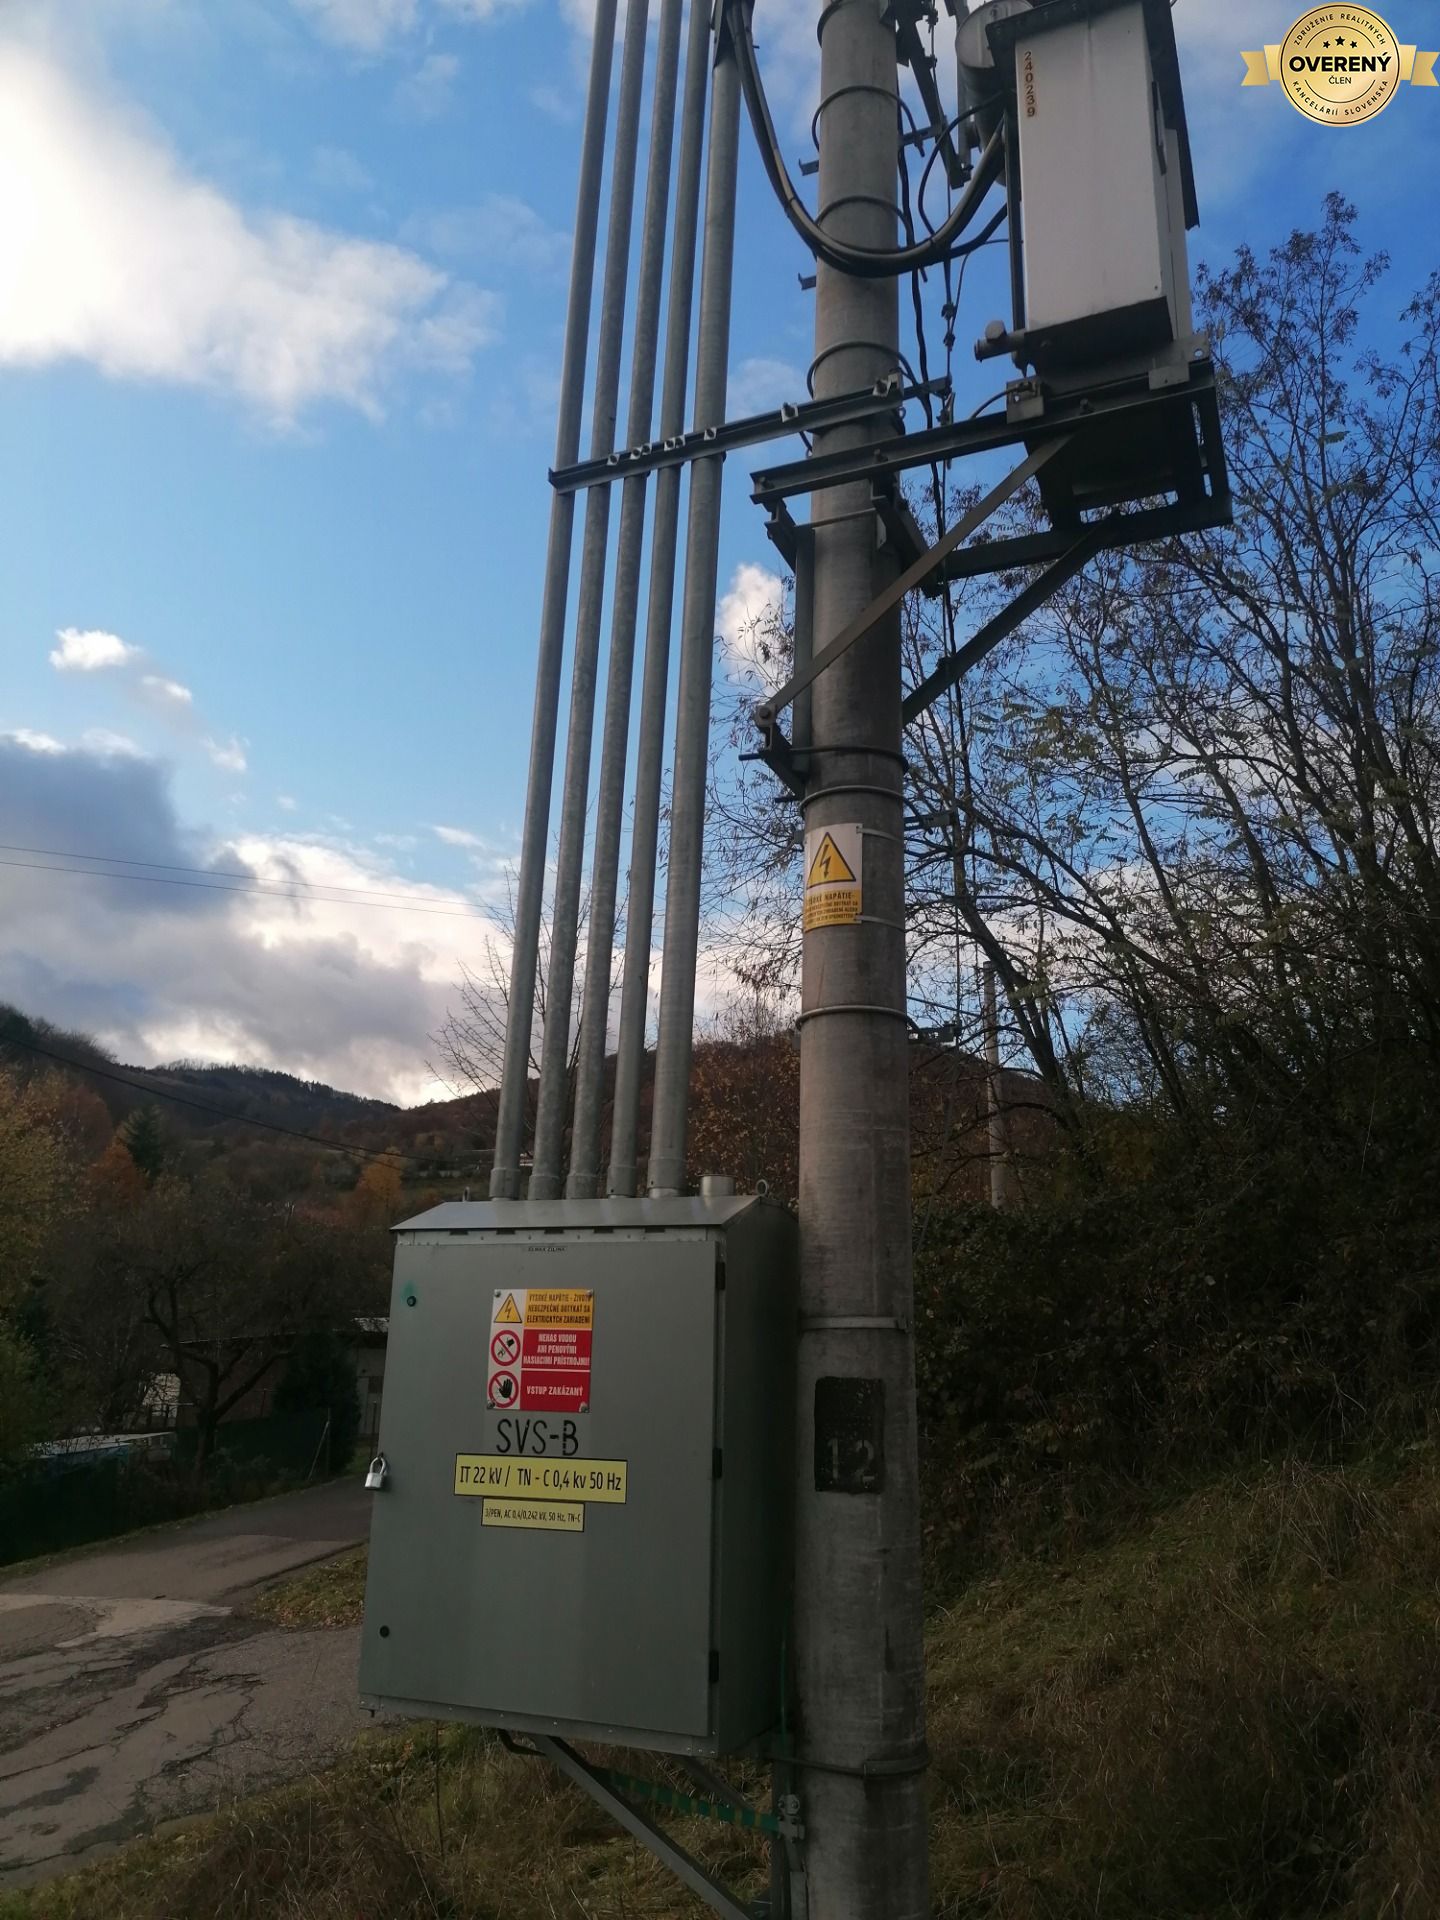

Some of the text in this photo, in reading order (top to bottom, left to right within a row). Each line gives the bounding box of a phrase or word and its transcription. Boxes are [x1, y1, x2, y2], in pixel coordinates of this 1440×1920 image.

[1025, 51, 1035, 117] 240239
[583, 1305, 591, 1313] SA
[558, 1333, 577, 1343] VODOU
[537, 1344, 547, 1354] ANI
[526, 1384, 584, 1397] VSTUP ZAKÁZANÝ
[496, 1418, 579, 1456] SVS-B
[460, 1466, 471, 1483] IT
[473, 1467, 486, 1484] 22
[489, 1467, 502, 1484] kV
[504, 1465, 511, 1487] /
[517, 1468, 531, 1486] TN
[543, 1469, 550, 1487] C
[553, 1470, 570, 1490] 0,4
[590, 1472, 603, 1490] 50
[607, 1473, 621, 1491] Hz
[504, 1508, 512, 1518] AC
[549, 1511, 556, 1522] 50
[567, 1513, 581, 1523] TN-C
